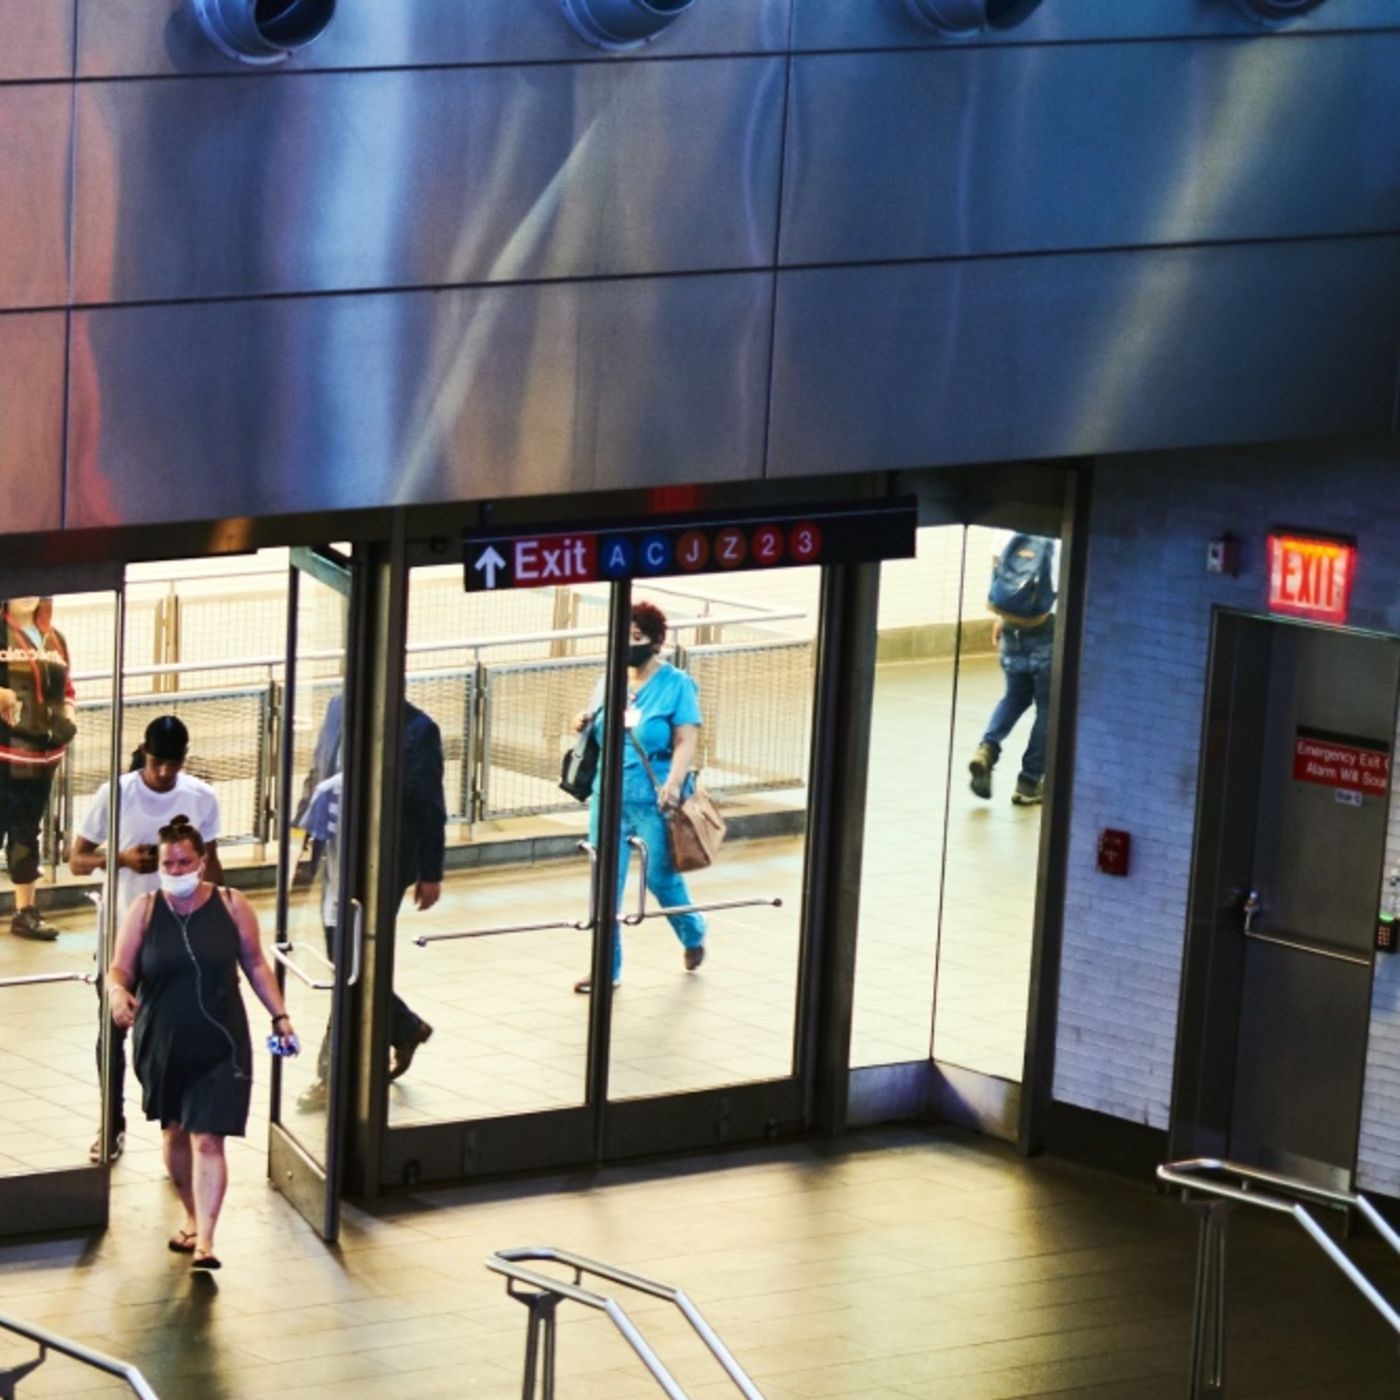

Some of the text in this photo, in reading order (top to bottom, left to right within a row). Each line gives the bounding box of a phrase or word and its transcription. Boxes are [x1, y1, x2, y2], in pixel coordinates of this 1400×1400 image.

[515, 530, 812, 580] Exit A C J Z 2 3
[1280, 541, 1338, 608] EXIT
[1296, 741, 1357, 766] Emergency
[1360, 753, 1381, 768] Exit
